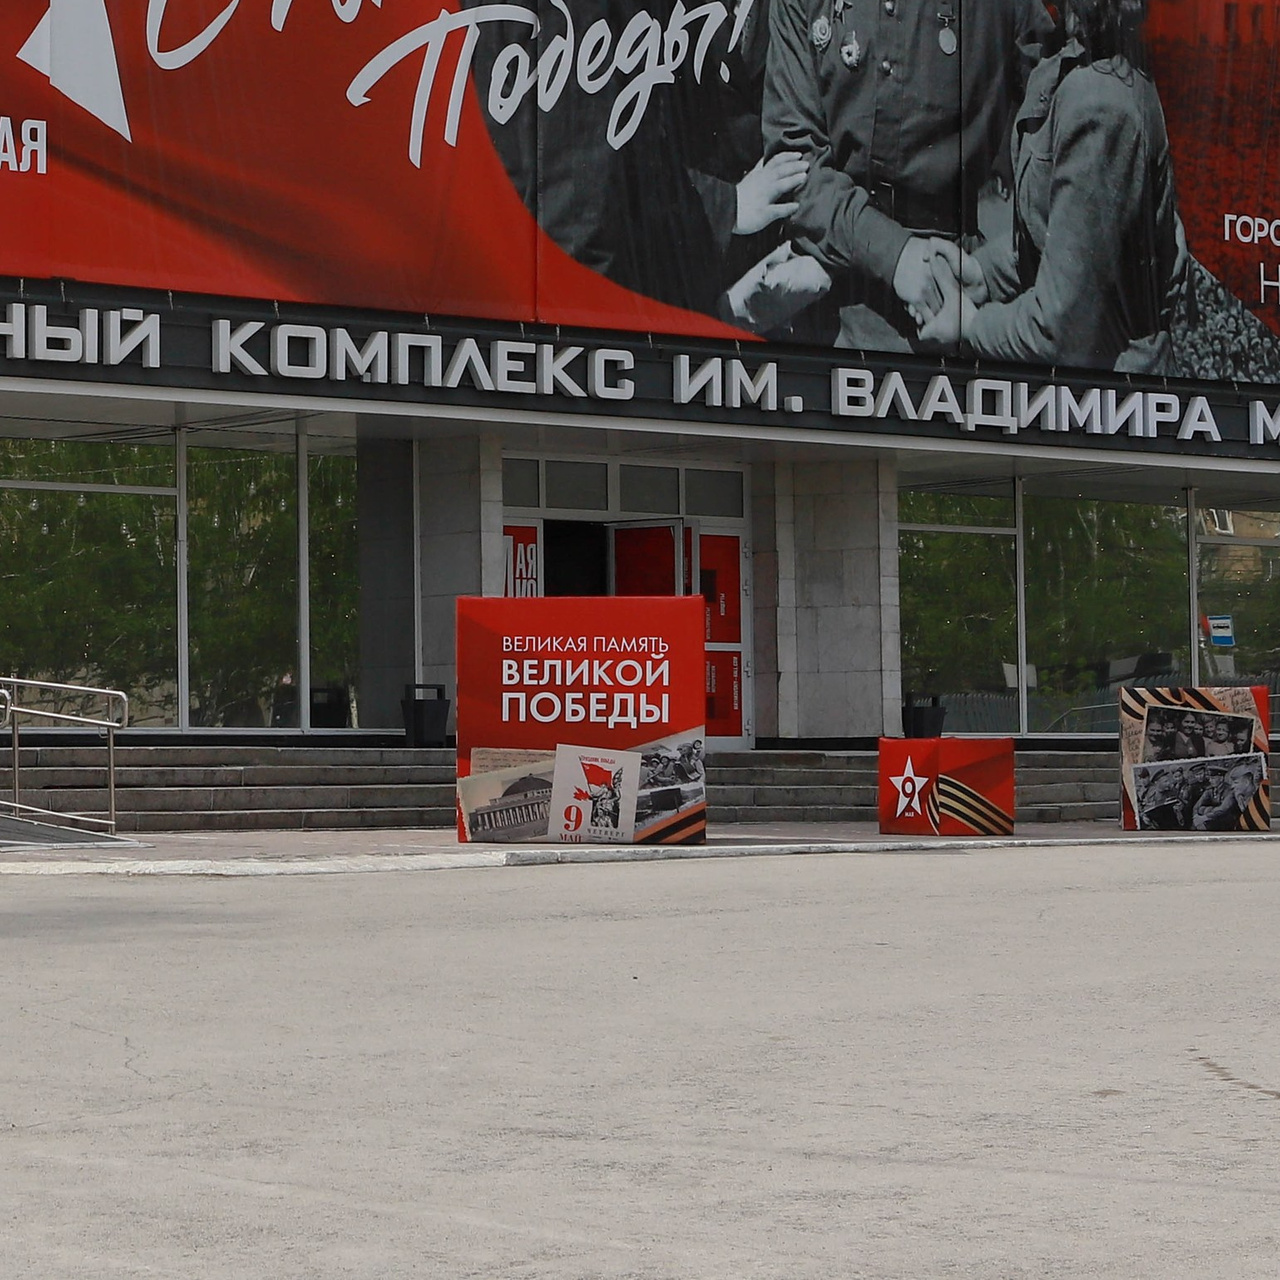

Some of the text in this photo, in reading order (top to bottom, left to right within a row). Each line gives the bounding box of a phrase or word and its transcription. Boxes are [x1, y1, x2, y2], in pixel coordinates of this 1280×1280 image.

[212, 318, 636, 401] КОМПЛЕКС
[673, 354, 804, 414] ИМ.
[831, 367, 1222, 443] ВЛАДИМИРА
[502, 636, 669, 653] ВЕЛИКАЯ ПАМЯТЬ
[501, 654, 670, 686] ВЕЛИКОЙ
[501, 692, 670, 729] ПОБЕДЫ
[901, 776, 916, 808] 9
[564, 805, 583, 832] 9
